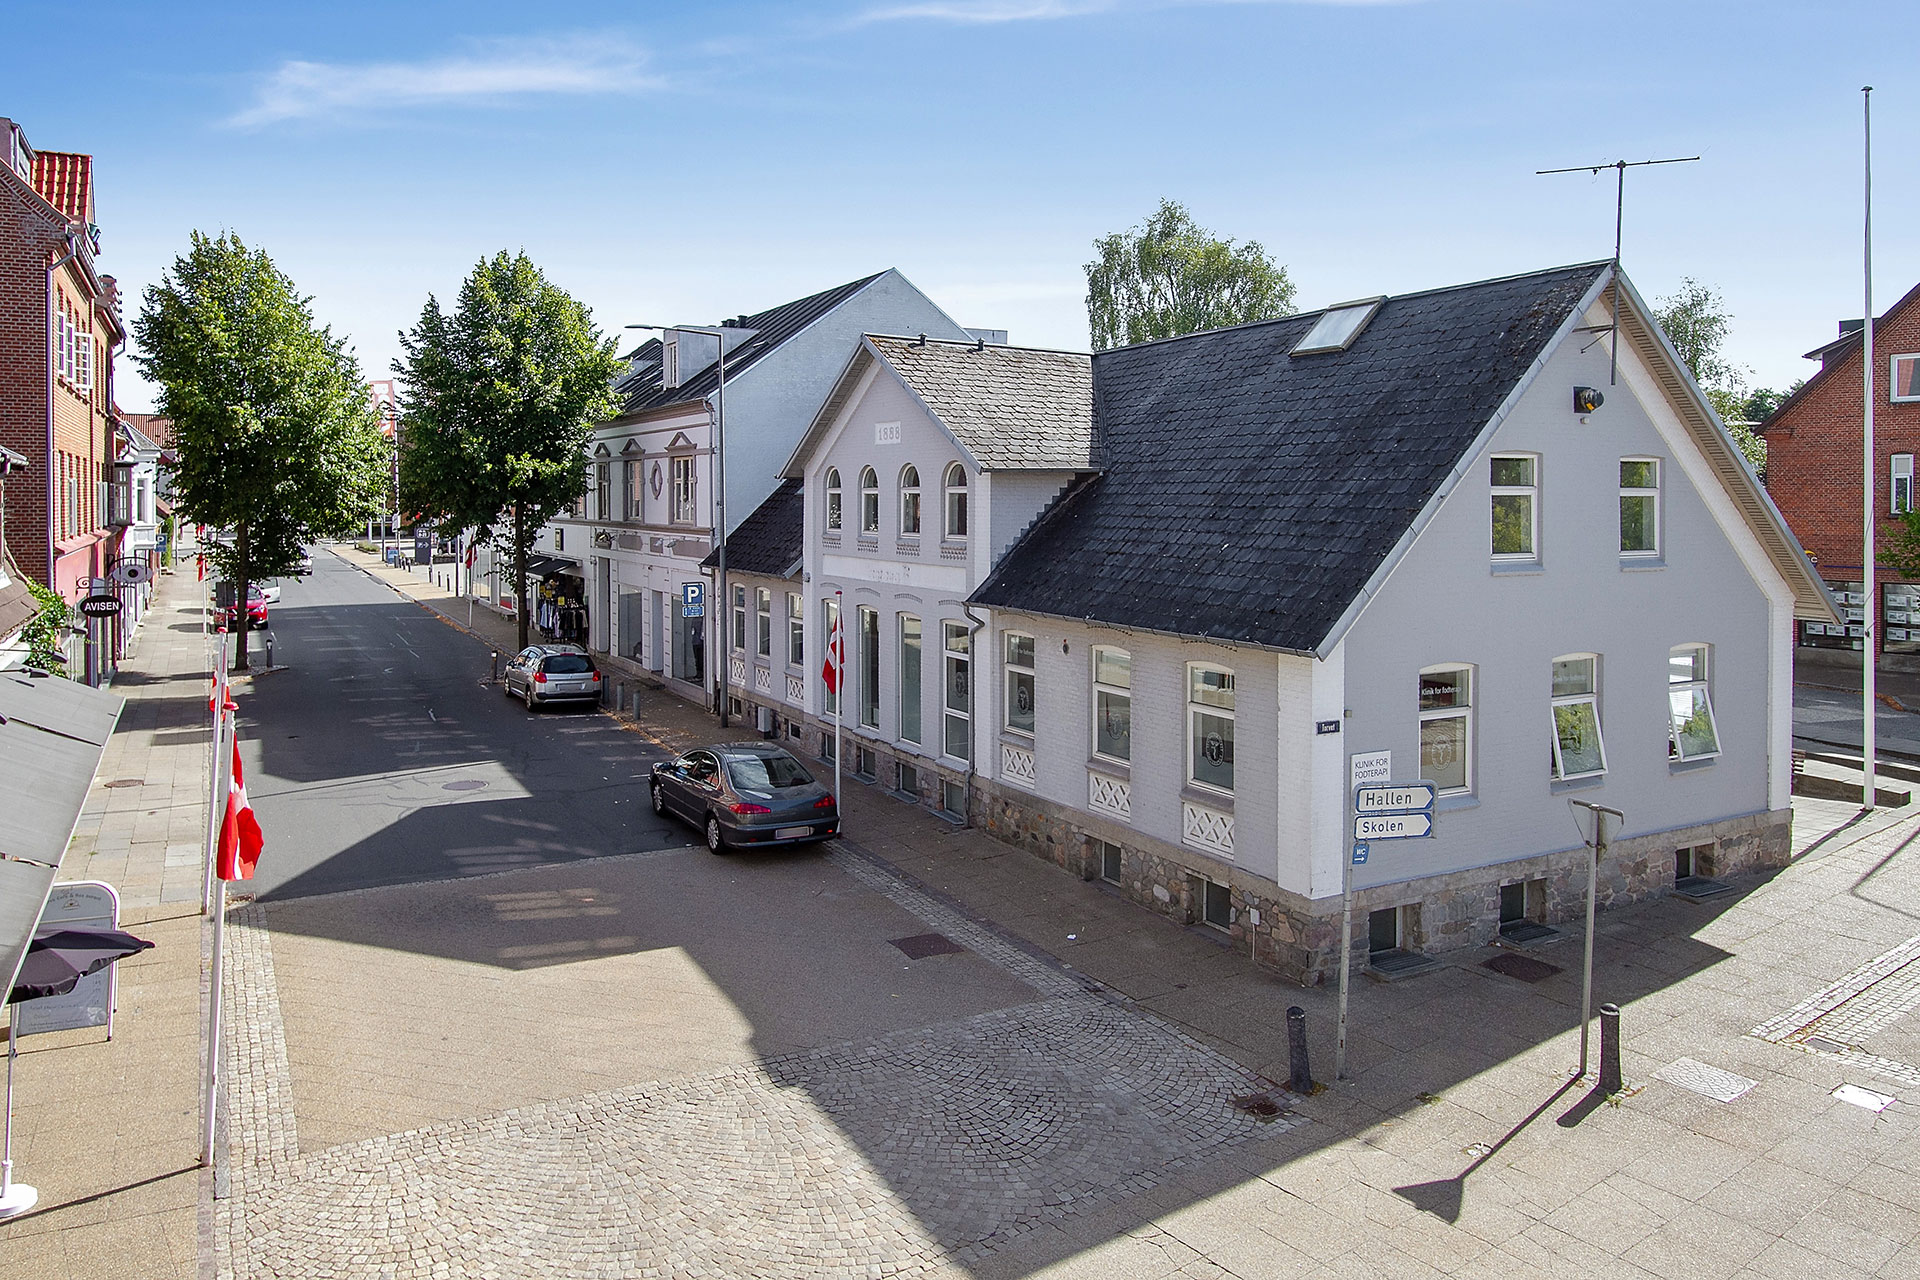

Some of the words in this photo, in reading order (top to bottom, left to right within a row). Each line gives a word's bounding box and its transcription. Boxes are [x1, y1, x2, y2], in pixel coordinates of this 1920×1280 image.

[878, 426, 900, 441] 1888
[687, 586, 700, 603] P
[85, 602, 119, 611] AVISEN
[1355, 760, 1375, 769] KLINIK
[1376, 758, 1389, 766] FOR
[1355, 768, 1389, 779] FODTERAPI
[1366, 792, 1412, 806] Hallen
[1362, 820, 1404, 834] Skolen
